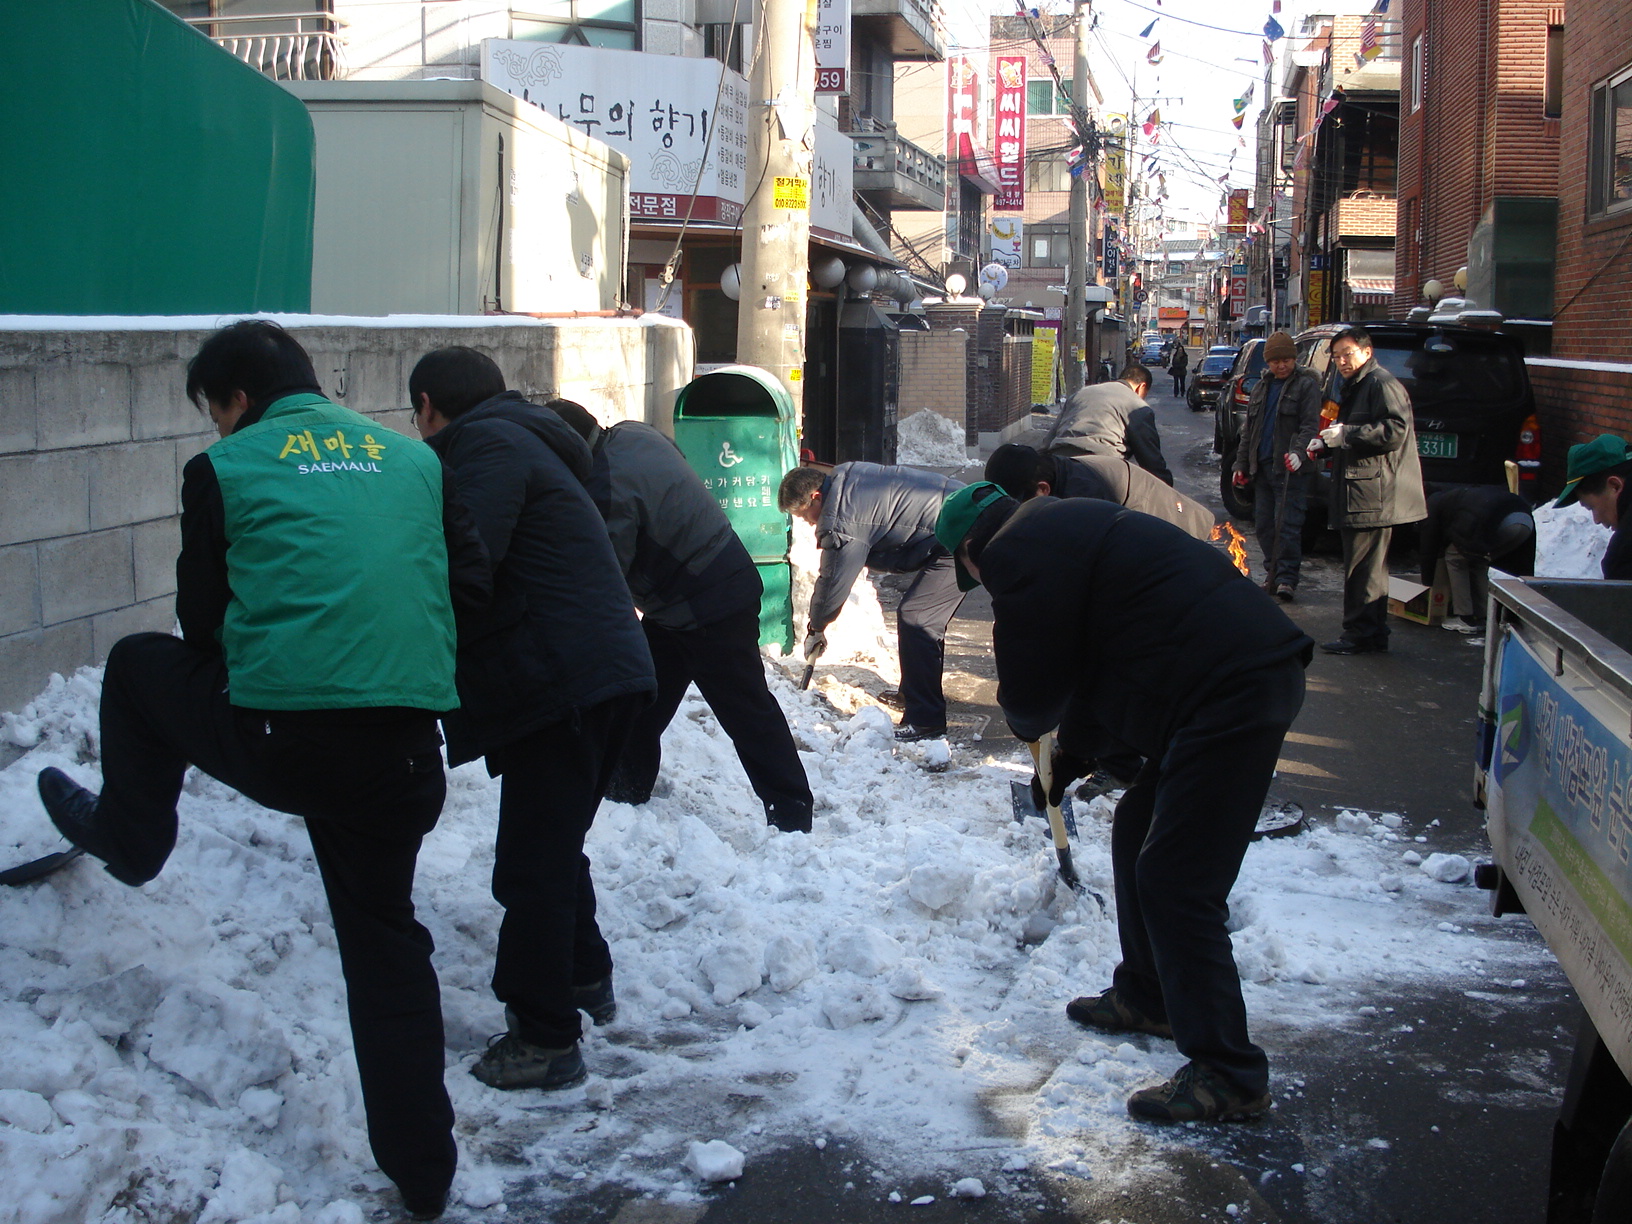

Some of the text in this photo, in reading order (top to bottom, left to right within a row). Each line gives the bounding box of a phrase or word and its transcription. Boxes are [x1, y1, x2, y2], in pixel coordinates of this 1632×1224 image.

[817, 71, 840, 89] 59
[508, 89, 709, 149] 무의 향기
[999, 92, 1021, 186] 씨씨월드
[818, 156, 836, 208] 향기
[279, 430, 386, 461] 새마을
[1422, 441, 1452, 456] 3311
[298, 461, 382, 474] SAEMAUL
[746, 475, 757, 508] 담요
